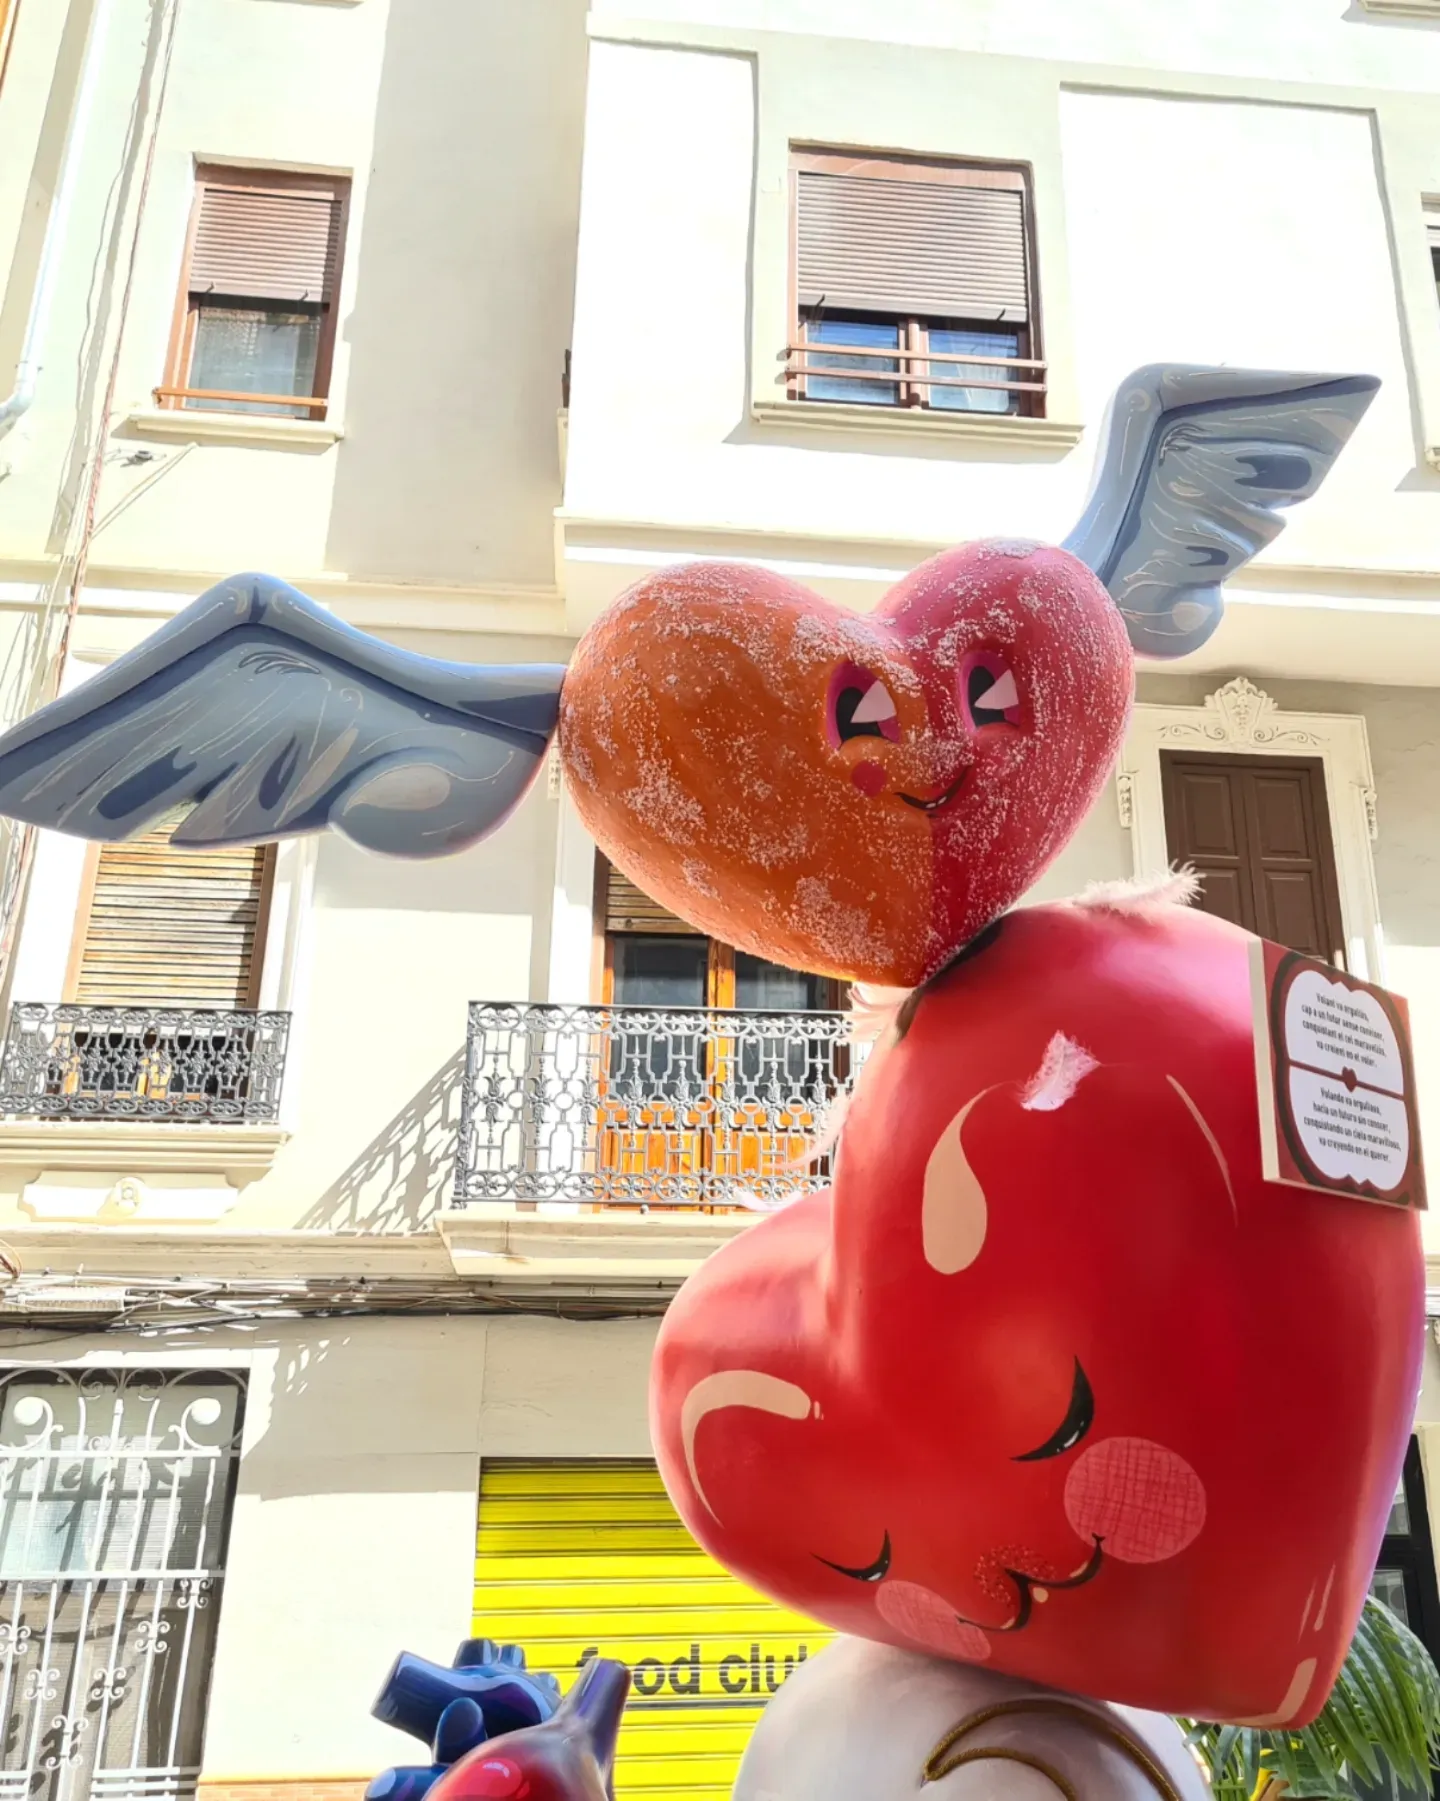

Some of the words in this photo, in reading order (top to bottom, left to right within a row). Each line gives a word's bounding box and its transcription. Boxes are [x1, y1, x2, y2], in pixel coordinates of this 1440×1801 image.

[1327, 1012, 1340, 1026] futur
[1342, 1019, 1358, 1032] sense
[1320, 1087, 1344, 1104] Volando
[1353, 1098, 1381, 1116] orgulloso,
[1313, 1101, 1328, 1115] hacia
[1339, 1108, 1356, 1122] futuro
[1368, 1118, 1390, 1133] conocer,
[1304, 1116, 1343, 1135] conquistando
[1353, 1128, 1366, 1141] cielo
[1368, 1134, 1401, 1151] maravilloso,
[1327, 1138, 1354, 1154] creyendo
